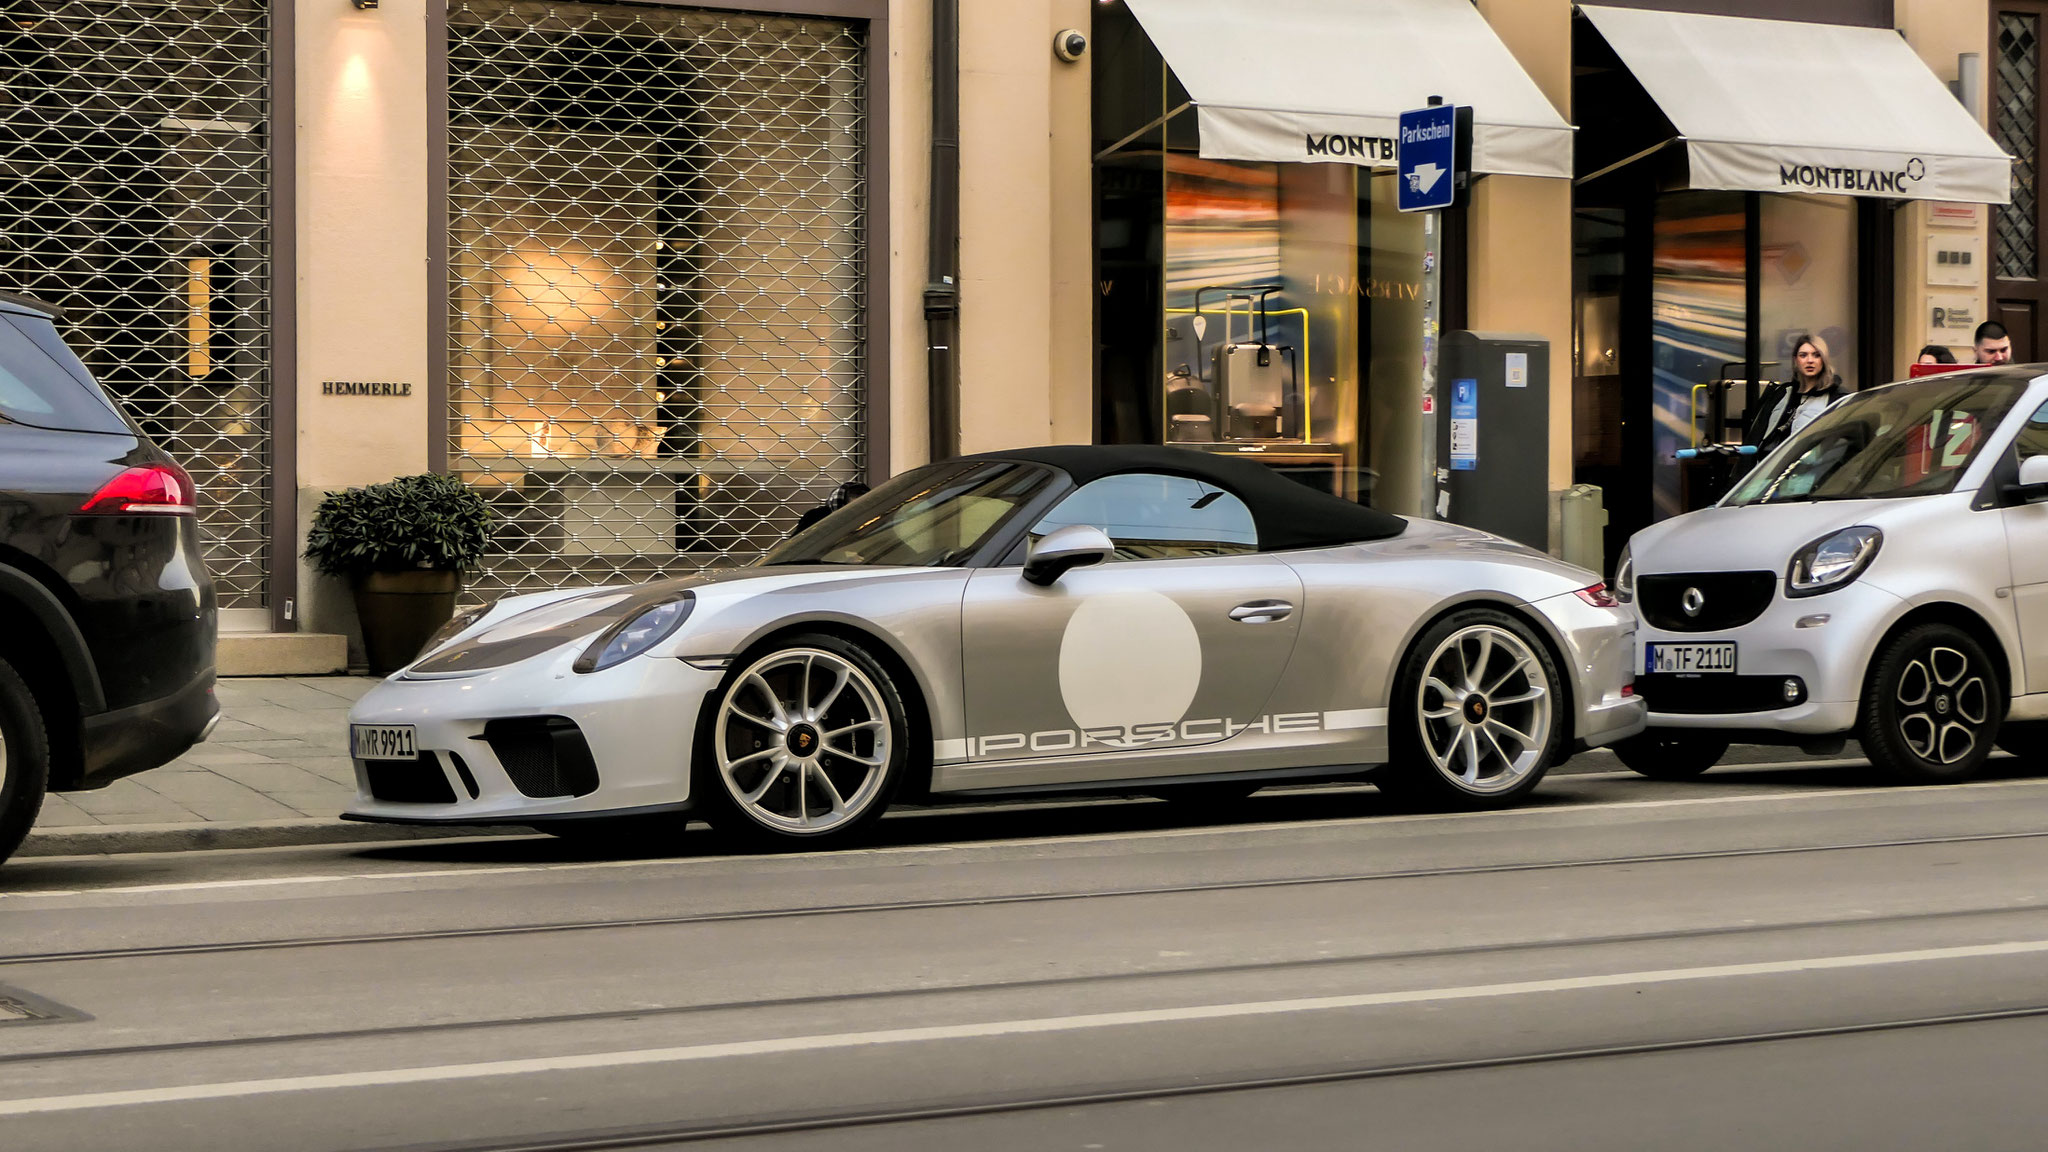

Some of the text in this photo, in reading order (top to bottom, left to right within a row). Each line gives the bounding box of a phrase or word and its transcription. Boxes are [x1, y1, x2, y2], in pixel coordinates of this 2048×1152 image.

[1402, 122, 1450, 144] Parkschein
[1780, 165, 1907, 193] MONTBLANC
[322, 382, 411, 396] HEMMERLE
[1654, 647, 1732, 669] M TF 2110
[365, 729, 379, 755] YR
[381, 729, 414, 756] 9911
[979, 712, 1320, 755] PORSCHE
